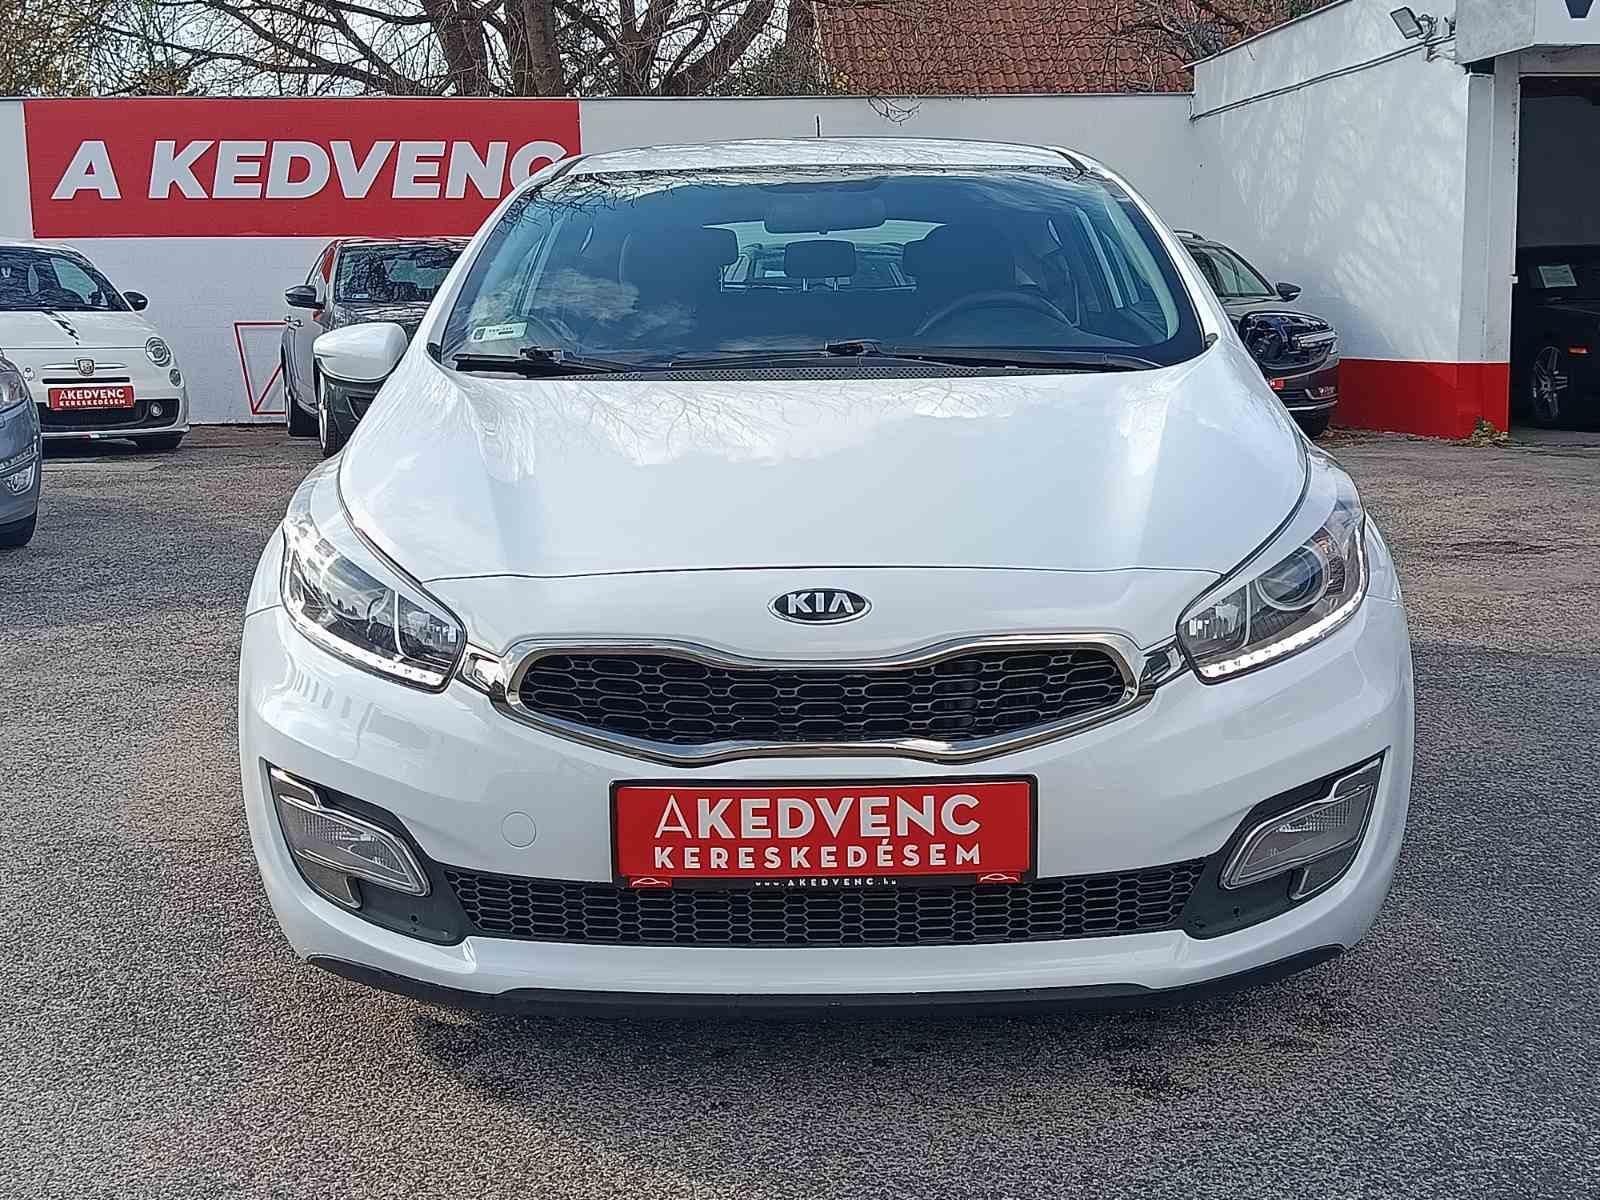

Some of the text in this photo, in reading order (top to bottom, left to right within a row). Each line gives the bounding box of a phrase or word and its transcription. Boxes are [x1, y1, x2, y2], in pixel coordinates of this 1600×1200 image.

[51, 140, 121, 200] A
[787, 592, 854, 614] KIA
[654, 840, 981, 869] KERESKEDÉSEM
